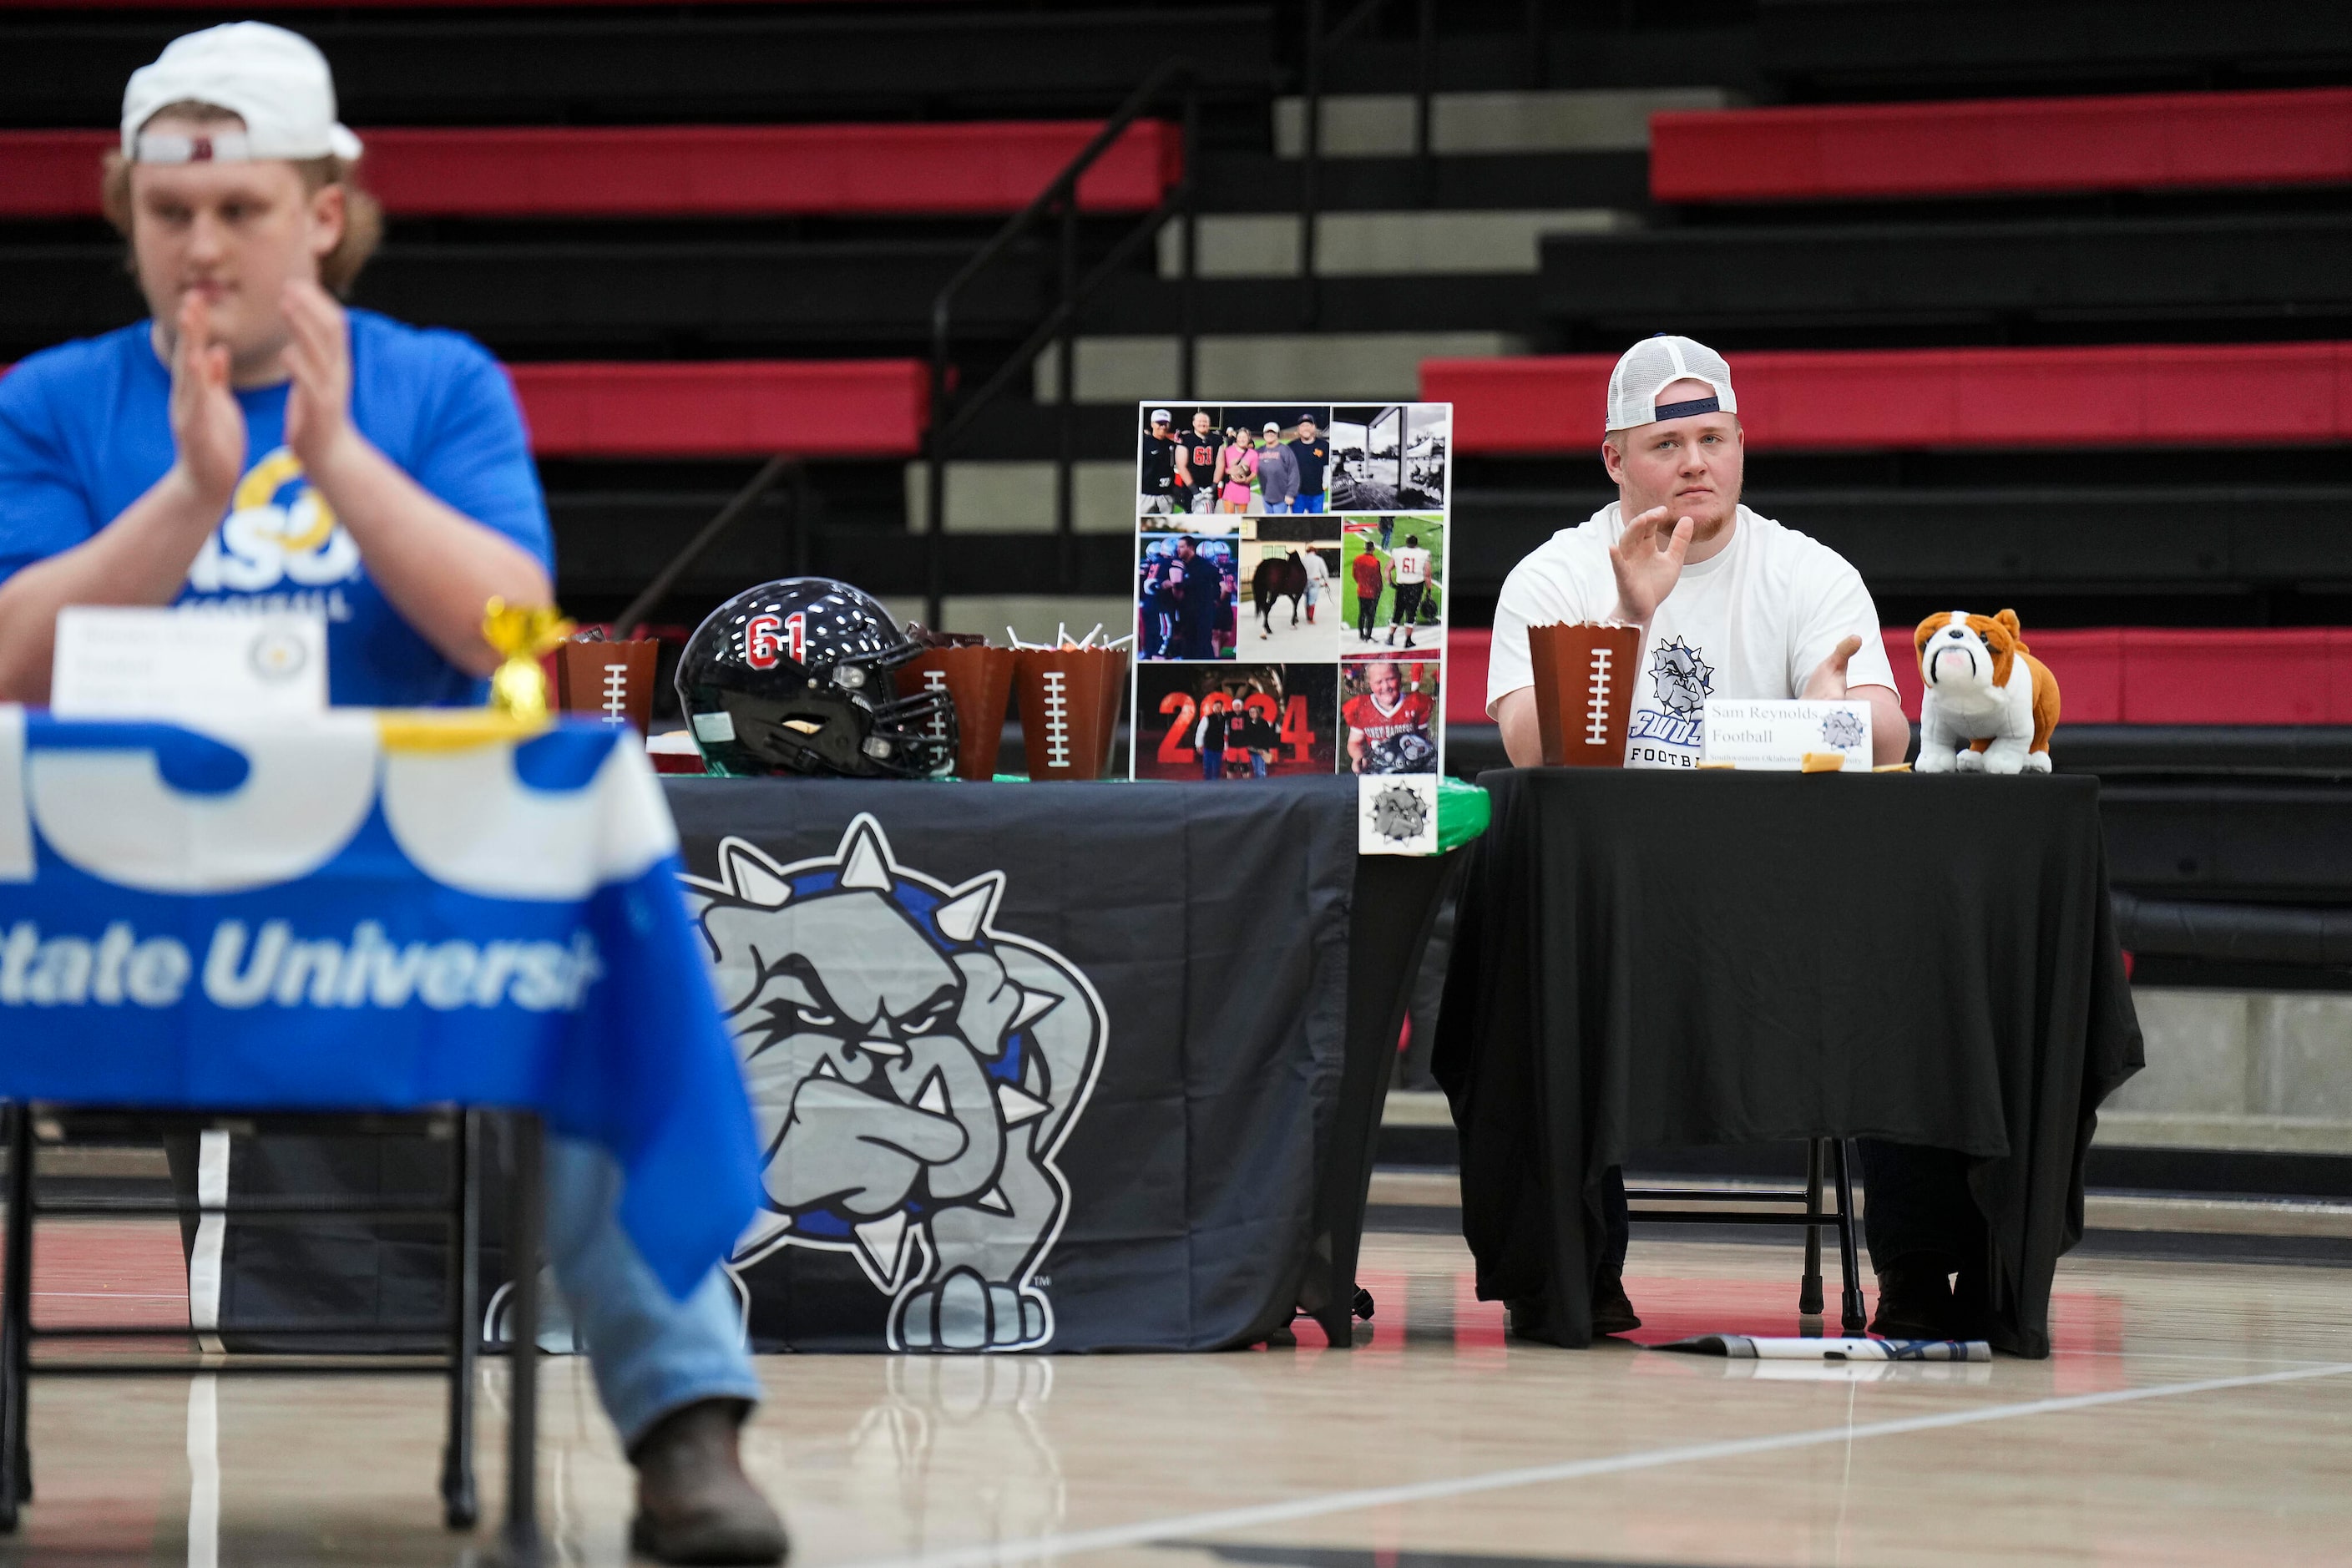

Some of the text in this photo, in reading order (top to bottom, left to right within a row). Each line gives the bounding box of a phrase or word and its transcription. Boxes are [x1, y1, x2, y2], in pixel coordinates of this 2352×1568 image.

[1193, 445, 1212, 466] 61
[1402, 557, 1416, 574] 61
[746, 611, 807, 670] 61
[1712, 705, 1818, 722] Sam Reynolds
[1712, 729, 1773, 743] Football
[1631, 748, 1701, 768] FOOTB
[1762, 754, 1801, 763] Oklahoma
[0, 918, 191, 1008] tate
